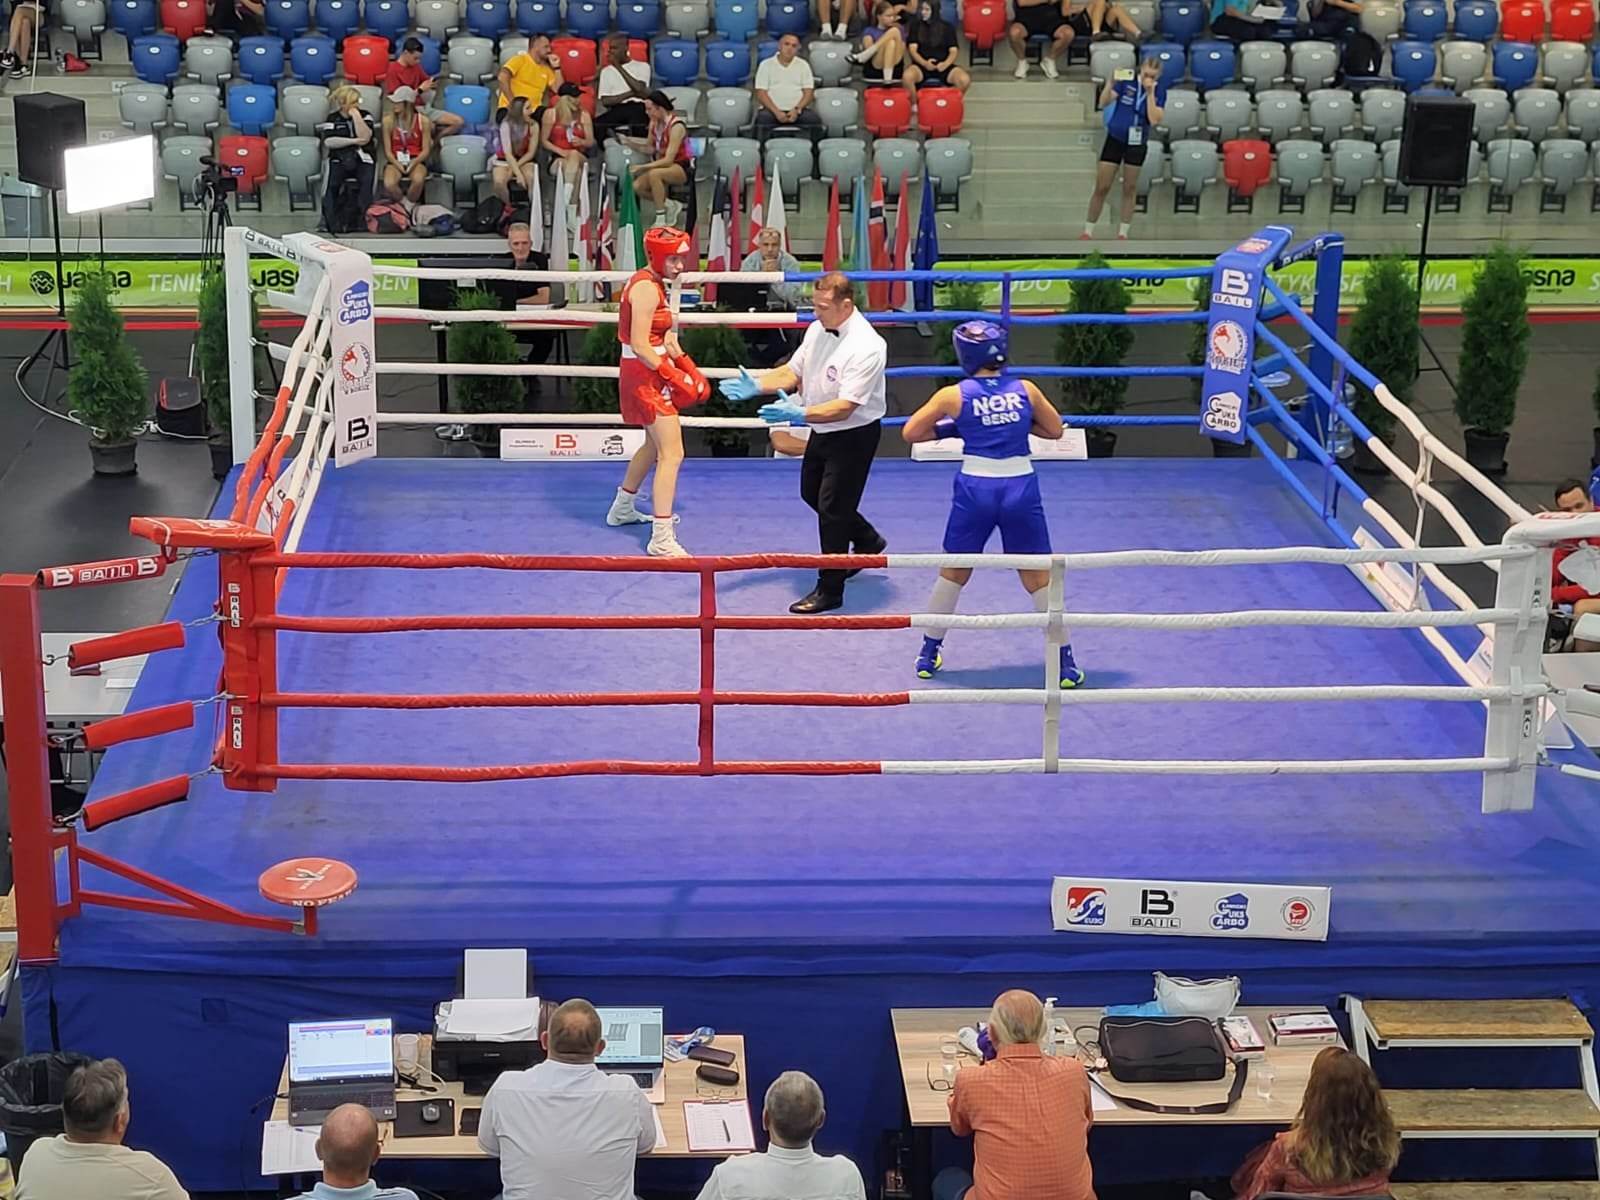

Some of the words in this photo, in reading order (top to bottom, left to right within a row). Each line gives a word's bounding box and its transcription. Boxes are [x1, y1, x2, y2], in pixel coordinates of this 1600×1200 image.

[1221, 269, 1249, 295] B
[1214, 294, 1251, 307] BAIL
[972, 392, 1024, 416] NOR
[348, 417, 370, 441] B
[556, 434, 577, 449] B
[53, 568, 74, 587] B
[80, 565, 132, 582] BAIL
[137, 557, 158, 576] B
[231, 596, 240, 627] BAIL
[233, 718, 242, 748] BAIL
[1141, 889, 1175, 915] B
[1131, 917, 1180, 928] BAIL
[1211, 914, 1246, 929] CARBO
[1229, 910, 1245, 919] UKS
